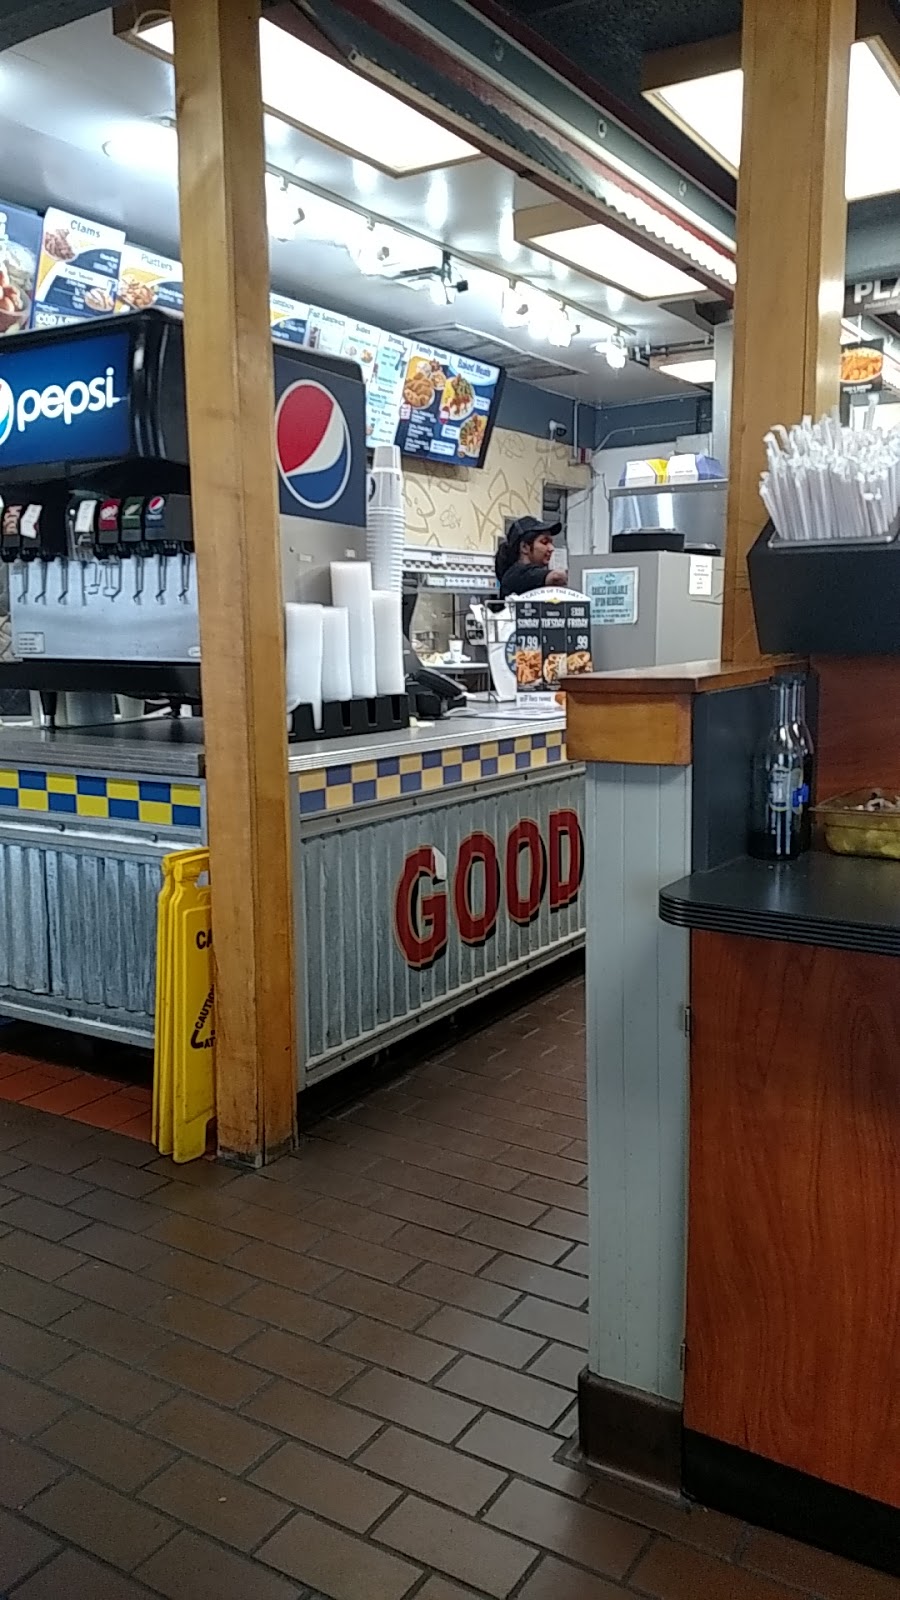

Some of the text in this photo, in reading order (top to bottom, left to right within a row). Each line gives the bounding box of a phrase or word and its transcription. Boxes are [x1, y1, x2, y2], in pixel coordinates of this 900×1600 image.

[70, 220, 101, 238] Clams
[141, 253, 173, 271] Platters
[416, 344, 432, 356] Family
[457, 358, 475, 373] Baked
[17, 367, 120, 432] pepsi
[517, 617, 589, 629] SUNDAY TUESDAY FRIDAY
[394, 808, 584, 971] GOOD
